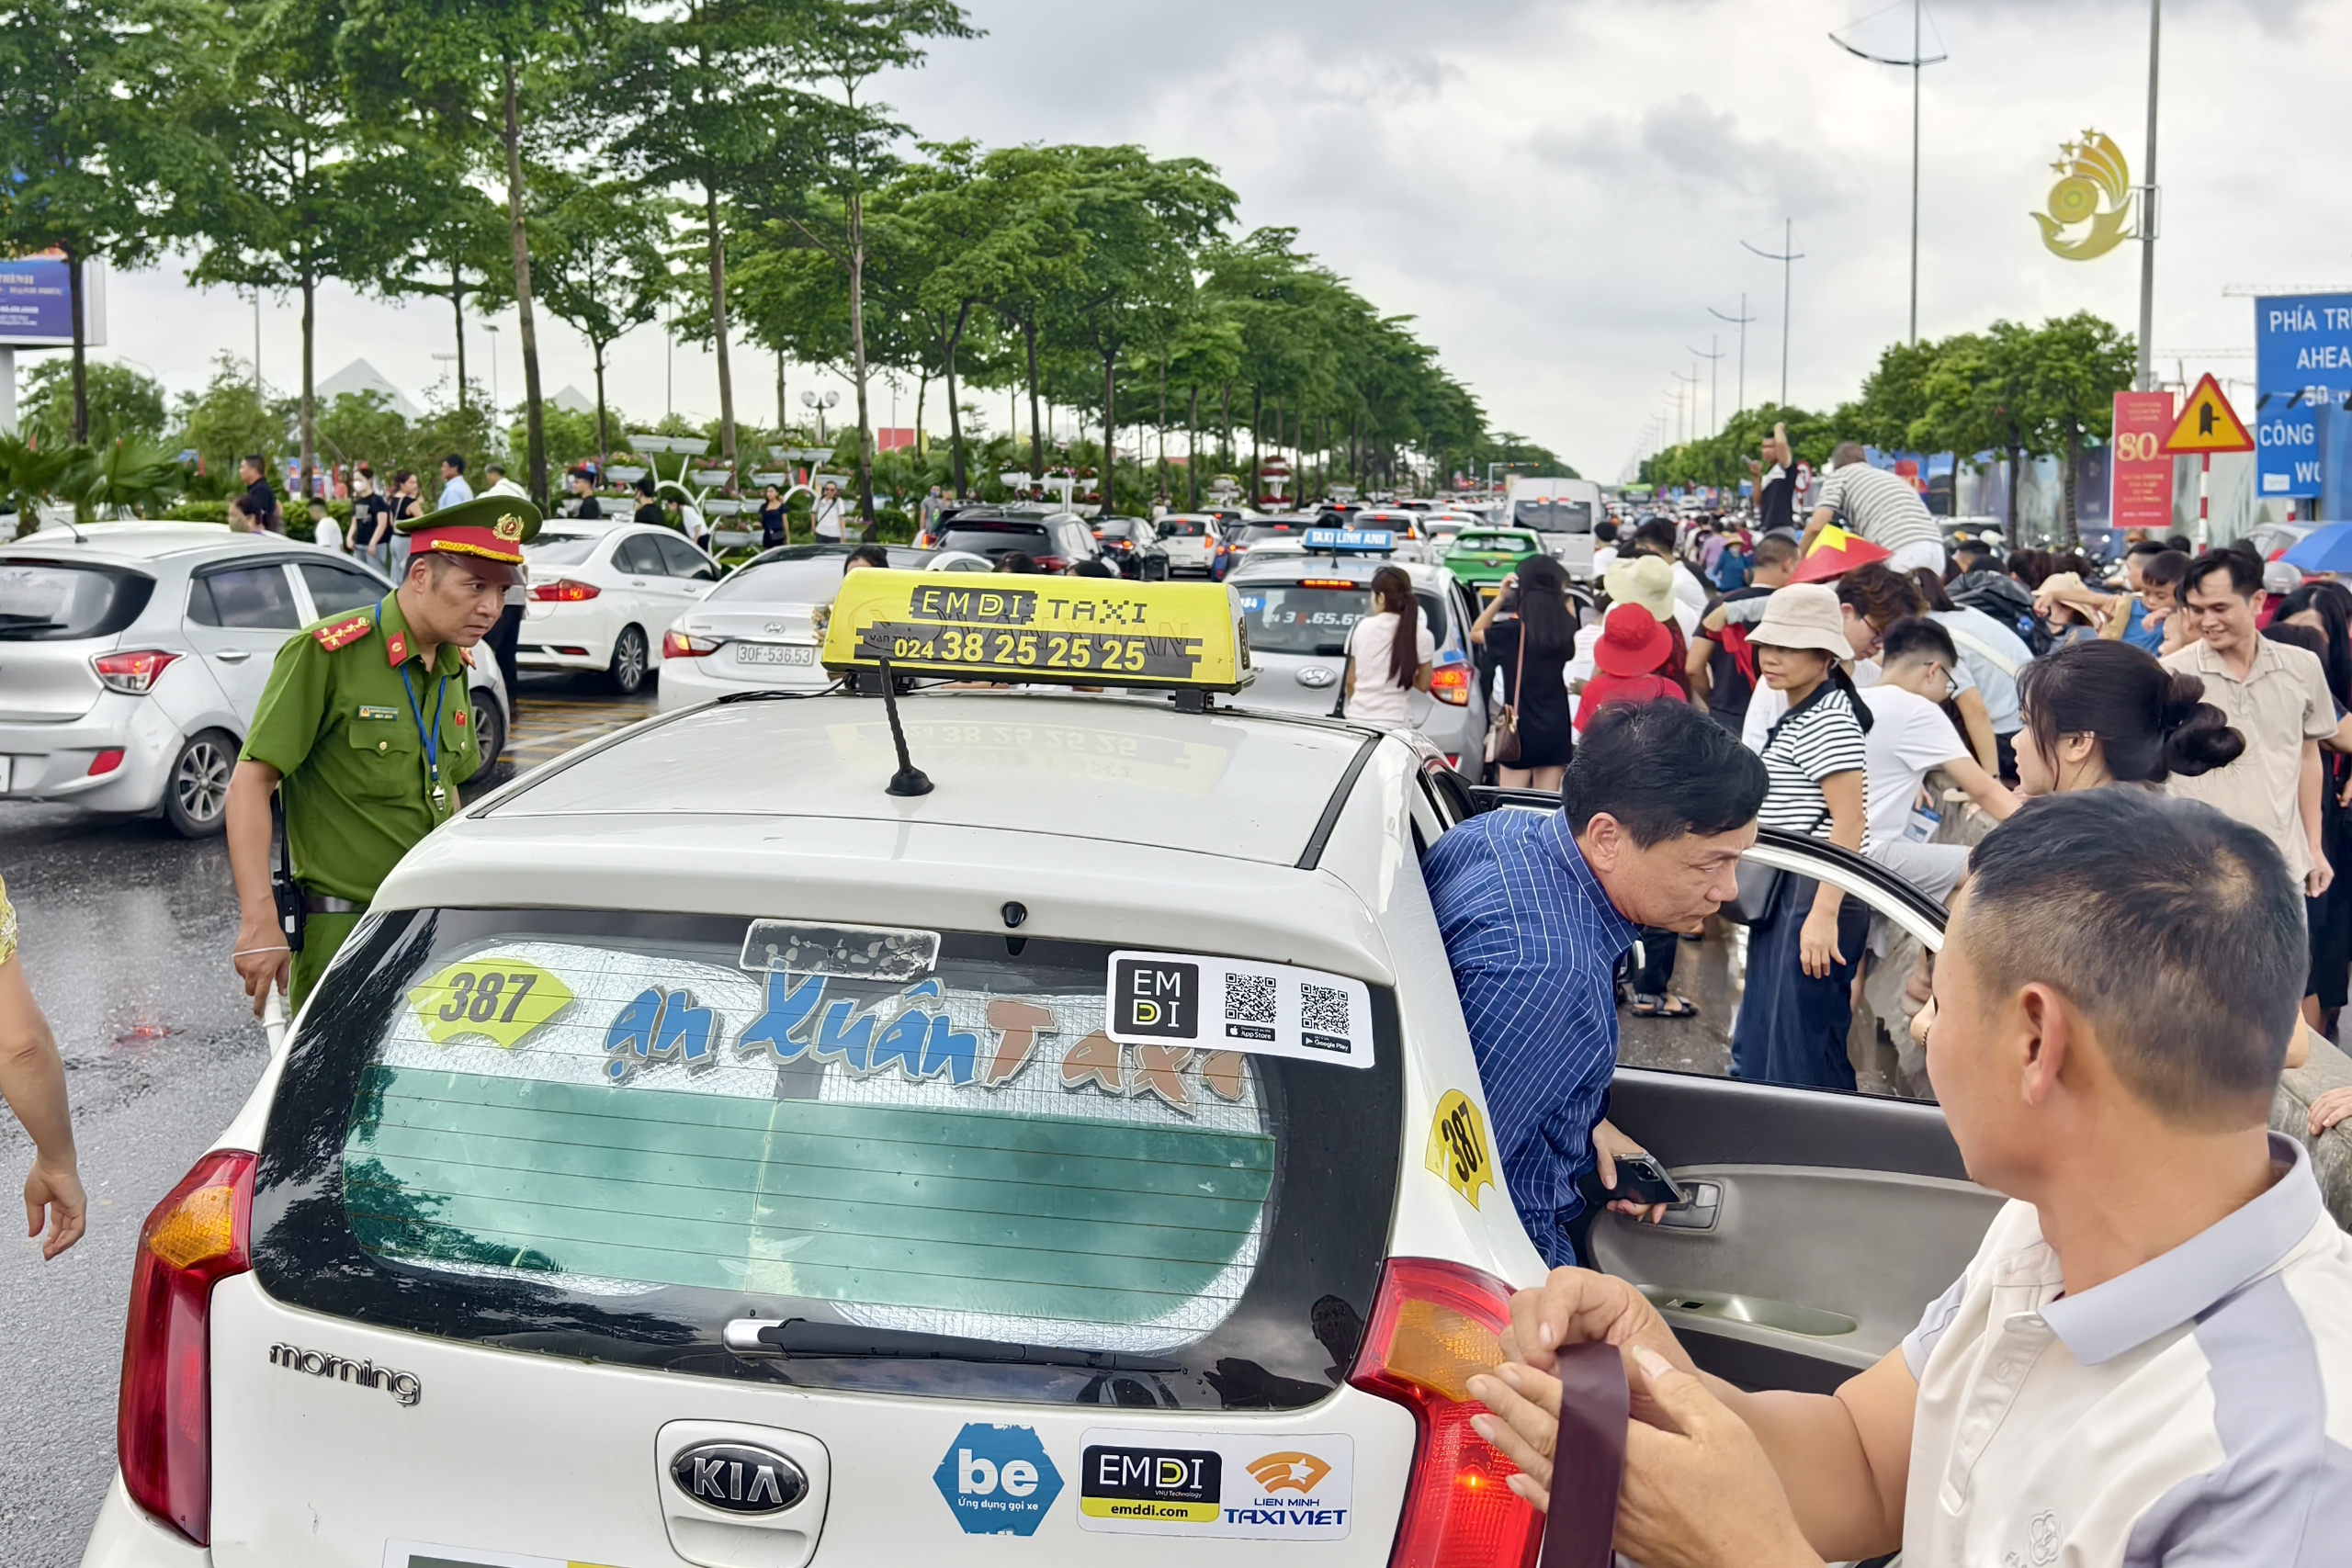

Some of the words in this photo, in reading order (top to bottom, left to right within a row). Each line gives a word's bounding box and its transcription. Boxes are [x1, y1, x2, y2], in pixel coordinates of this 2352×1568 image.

[2269, 304, 2317, 333] PHÍA
[2324, 308, 2352, 332] TR
[2117, 432, 2159, 462] 80
[1312, 531, 1335, 544] TAXI
[922, 591, 1023, 618] EMDI
[1047, 599, 1148, 625] TAXI
[894, 639, 935, 660] 024
[941, 631, 984, 662] 38
[994, 634, 1037, 666] 25
[1047, 637, 1091, 669] 25
[1102, 639, 1146, 671] 25
[439, 972, 538, 1023] 387
[1133, 969, 1181, 998] EM
[1314, 1039, 1336, 1048] Google
[1441, 1100, 1485, 1183] 387
[268, 1341, 422, 1407] morning
[694, 1457, 783, 1504] KIA
[958, 1449, 1039, 1497] be
[957, 1495, 979, 1509] Ứng
[980, 1499, 1007, 1511] dụng
[1008, 1500, 1024, 1512] gọi
[1026, 1503, 1039, 1511] xe
[1169, 1491, 1203, 1499] Technology
[1254, 1497, 1283, 1506] LIEN
[1287, 1498, 1320, 1506] MINH
[1111, 1504, 1189, 1517] emddi.com
[1224, 1508, 1286, 1525] TAXI
[1288, 1509, 1348, 1526] VIET
